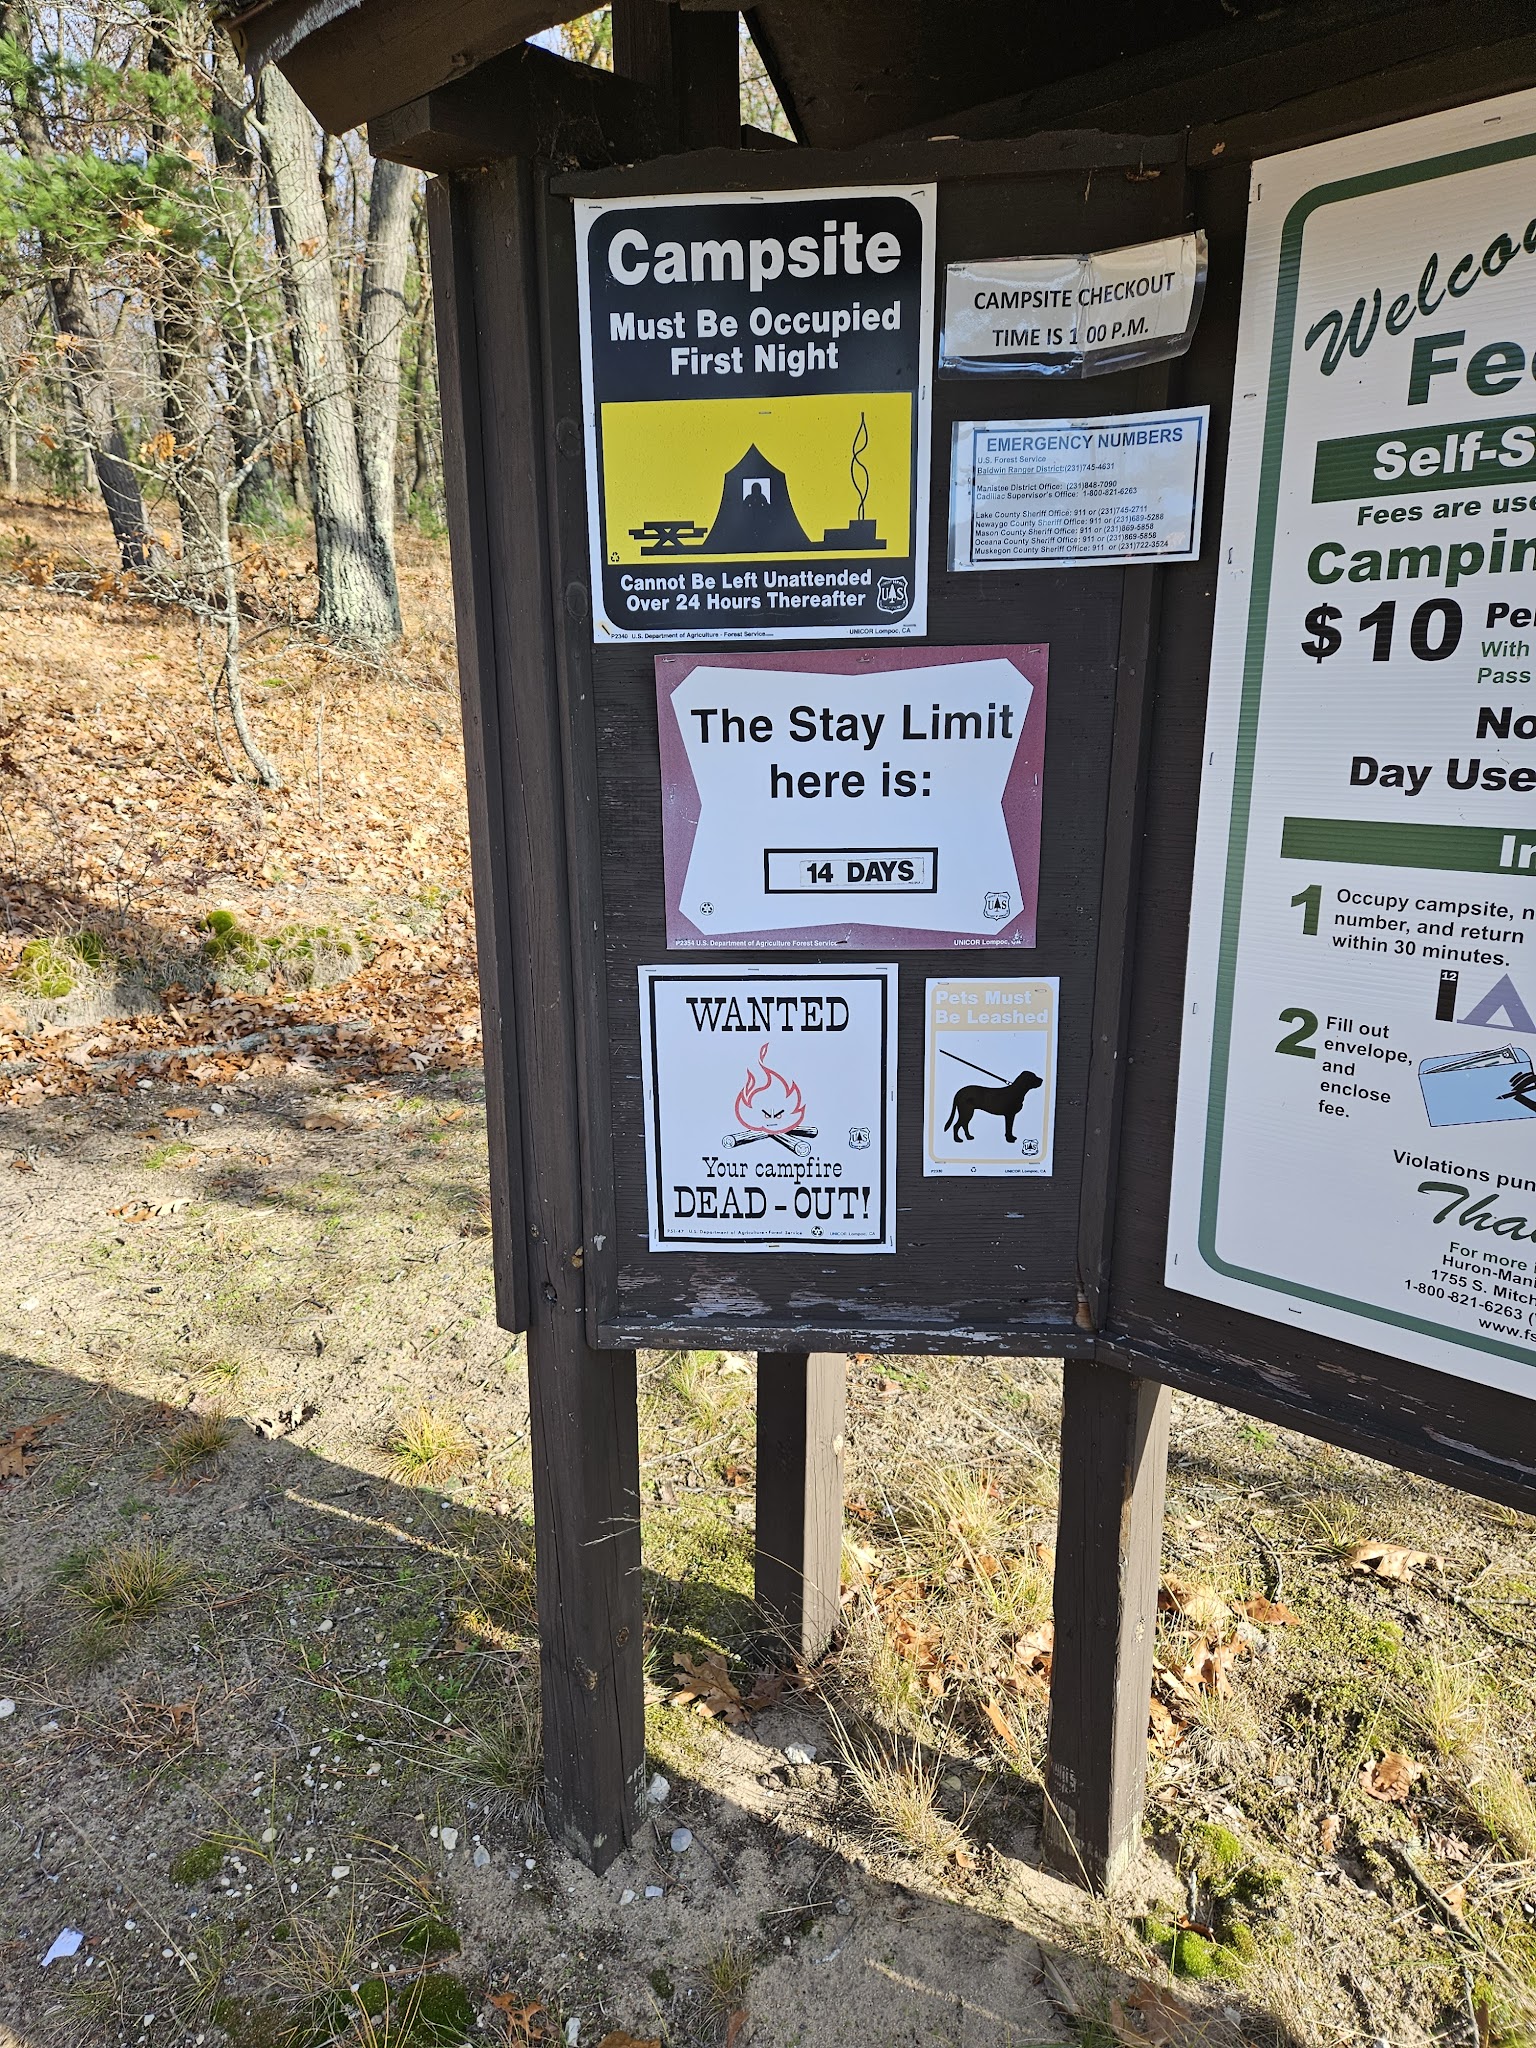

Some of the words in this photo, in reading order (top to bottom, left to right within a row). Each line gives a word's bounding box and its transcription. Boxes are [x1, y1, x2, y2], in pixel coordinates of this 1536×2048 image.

[608, 220, 901, 292] Campsite
[974, 289, 1072, 310] CAMPSITE
[1078, 272, 1176, 307] CHECKOUT
[609, 312, 685, 341] Must
[697, 309, 738, 338] Be
[749, 301, 901, 338] Occupied
[992, 328, 1041, 347] TIME
[1047, 328, 1063, 345] IS
[1111, 317, 1149, 340] P.M.
[671, 346, 743, 375] First
[754, 342, 839, 377] Night
[1408, 329, 1536, 406] Fe
[987, 435, 1093, 452] EMERGENCY
[1098, 427, 1183, 449] NUMBERS
[977, 456, 993, 464] U.S.
[994, 456, 1018, 464] Forest
[1020, 455, 1047, 463] Service
[1008, 466, 1034, 475] Ranger
[976, 484, 1009, 492] Manistee
[976, 492, 1006, 500] Cadillac
[1006, 491, 1052, 500] Supervisor's
[1054, 490, 1079, 498] Office:
[975, 511, 993, 519] Lake
[994, 511, 1020, 519] County
[1022, 510, 1047, 518] Sheriff
[1048, 509, 1072, 517] Office:
[1010, 520, 1036, 528] County
[1038, 519, 1062, 527] Sheriff
[1063, 518, 1088, 526] Office:
[1357, 505, 1423, 526] Fees
[1432, 500, 1482, 519] are
[974, 538, 1002, 546] Oceana
[1003, 538, 1030, 546] County
[1031, 537, 1056, 545] Sheriff
[1056, 536, 1081, 544] Office:
[1000, 529, 1026, 537] County
[1028, 528, 1053, 536] Sheriff
[1080, 526, 1092, 534] 911
[974, 548, 1011, 556] Muskegon
[1012, 547, 1039, 555] County
[1040, 546, 1065, 554] Sheriff
[620, 573, 687, 591] Cannot
[691, 572, 715, 589] Be
[722, 571, 758, 588] Left
[763, 568, 872, 588] Unattended
[626, 594, 670, 611] Over
[676, 593, 701, 610] 24
[707, 592, 761, 610] Hours
[767, 590, 866, 607] Thereafter
[1486, 602, 1536, 628] Pe
[644, 632, 678, 640] Department
[1300, 597, 1464, 664] $10
[1481, 640, 1530, 658] With
[1477, 668, 1531, 684] Pass
[690, 708, 773, 744] The
[788, 705, 885, 751] Stay
[902, 702, 1014, 740] Limit
[1476, 706, 1536, 740] No
[770, 764, 865, 798] here
[882, 762, 932, 797] is:
[1350, 756, 1433, 796] Day
[1446, 758, 1536, 792] Use
[806, 862, 834, 884] 14
[847, 860, 914, 882] DAYS
[1290, 884, 1322, 936] 1
[1336, 889, 1409, 912] Occupy
[1415, 898, 1514, 922] campsite,
[1334, 912, 1410, 935] number,
[1417, 922, 1454, 937] and
[1460, 925, 1524, 944] return
[710, 940, 746, 948] Department
[755, 940, 791, 948] Agriculture
[1332, 934, 1388, 952] within
[1394, 939, 1416, 956] 30
[1422, 944, 1510, 966] minutes.
[1441, 972, 1458, 982] 12
[936, 990, 979, 1005] Pets
[985, 990, 1032, 1005] Must
[685, 996, 849, 1032] WANTED
[935, 1009, 961, 1024] Be
[967, 1009, 1048, 1024] Leashed
[1274, 1007, 1319, 1060] 2
[1326, 1016, 1353, 1033] Fill
[1358, 1021, 1390, 1039] out
[1324, 1038, 1414, 1066] envelope,
[1322, 1060, 1356, 1077] and
[1320, 1080, 1392, 1103] enclose
[1318, 1100, 1350, 1118] fee.
[702, 1156, 749, 1179] Your
[755, 1157, 843, 1184] campfire
[1393, 1149, 1490, 1182] Violations
[1496, 1174, 1536, 1192] pun
[674, 1186, 767, 1220] DEAD
[794, 1187, 871, 1220] OUT!
[1418, 1181, 1536, 1244] Tha
[1450, 1241, 1478, 1258] For
[1482, 1251, 1528, 1271] more
[1431, 1269, 1468, 1288] 1755
[1472, 1279, 1487, 1294] S.
